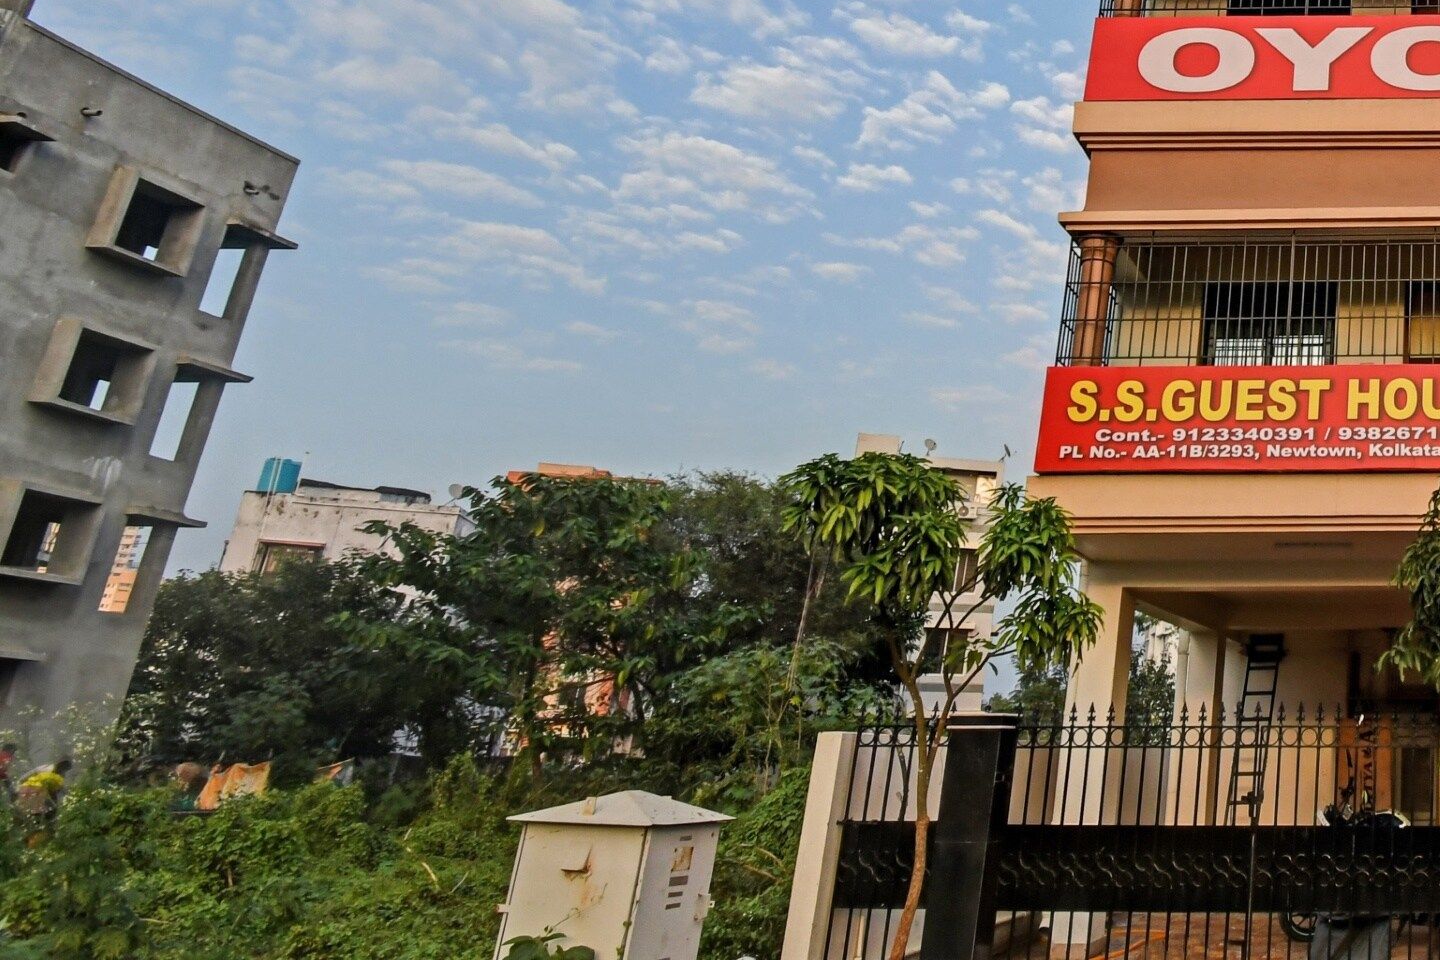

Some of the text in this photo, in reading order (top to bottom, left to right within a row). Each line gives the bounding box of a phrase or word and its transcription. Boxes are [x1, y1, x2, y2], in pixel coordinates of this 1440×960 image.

[1068, 379, 1330, 421] S.S.GUEST
[1096, 429, 1163, 441] Cont.-
[1173, 428, 1313, 441] 9123340391
[1324, 427, 1331, 440] /
[1060, 446, 1082, 458] PL
[1090, 446, 1126, 458] No.-
[1133, 445, 1259, 459] AA-11B/3293,
[1267, 445, 1361, 458] Newtown,
